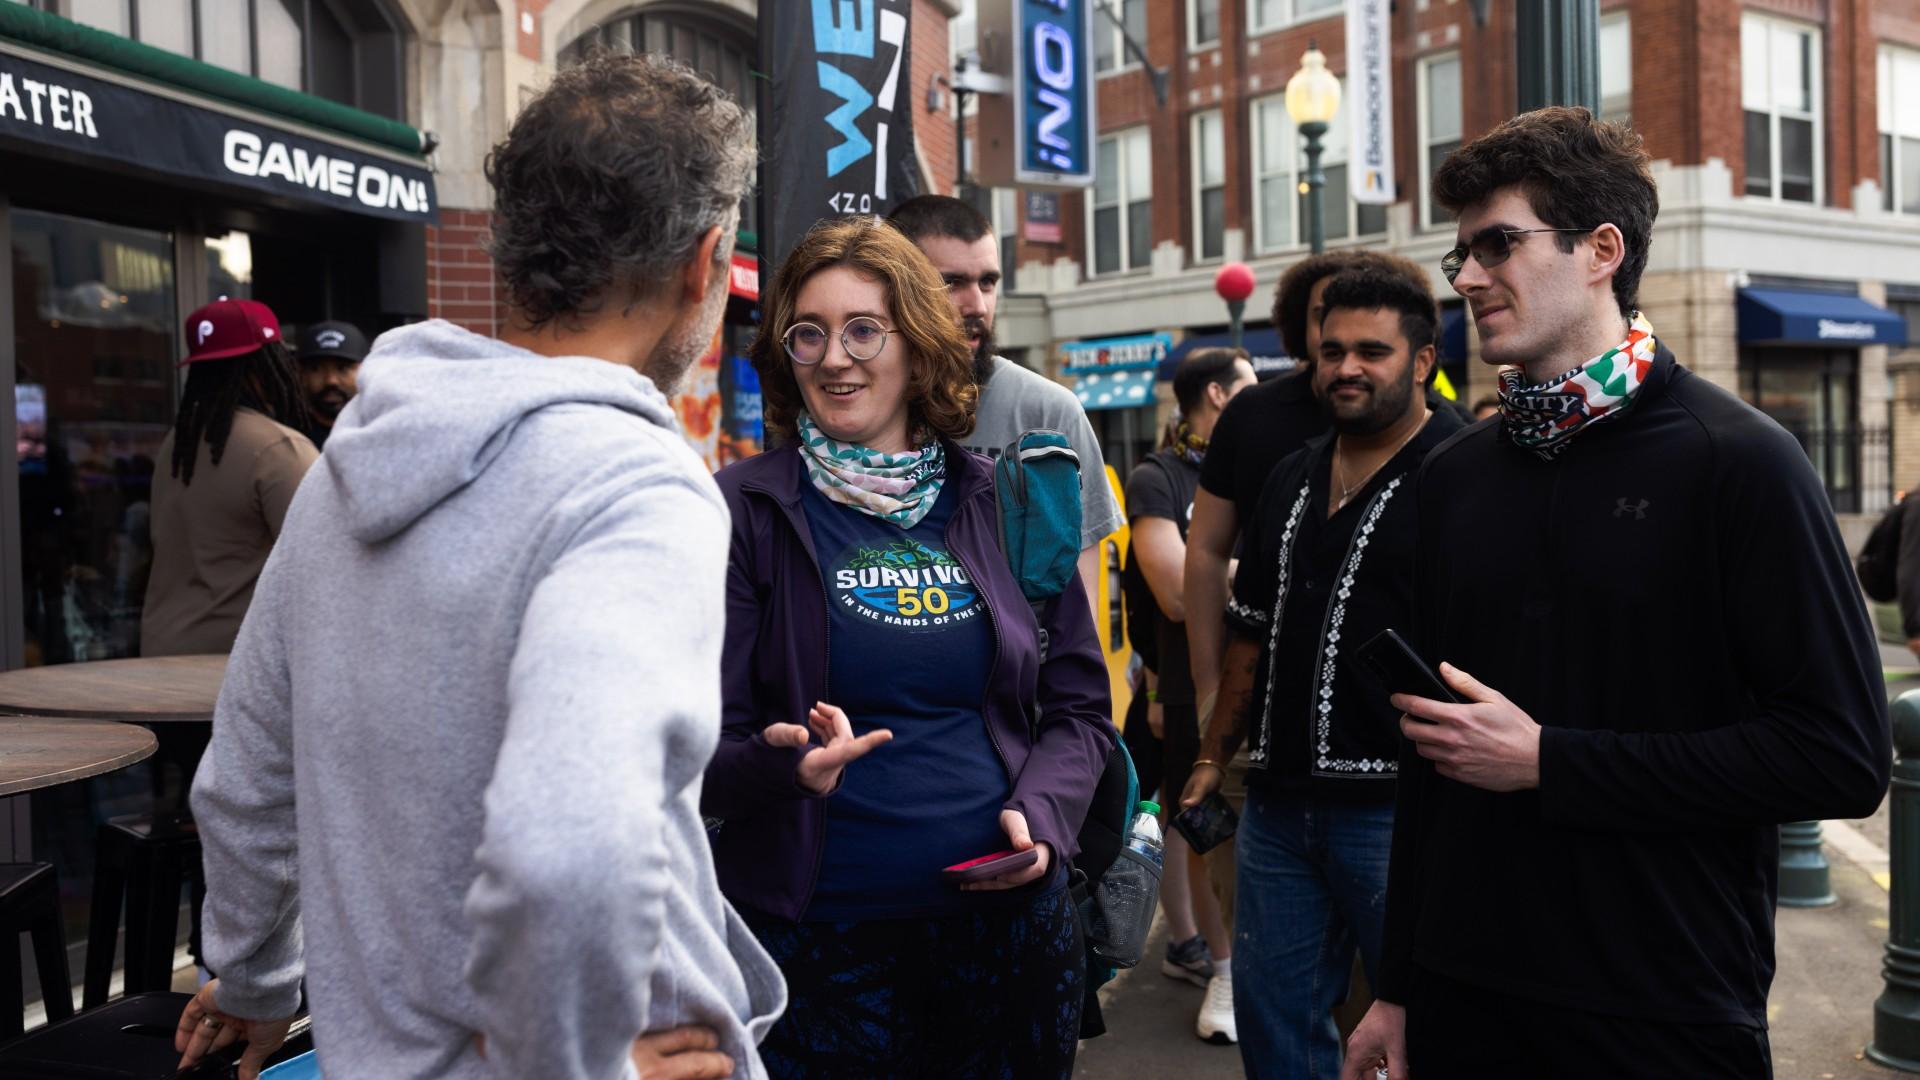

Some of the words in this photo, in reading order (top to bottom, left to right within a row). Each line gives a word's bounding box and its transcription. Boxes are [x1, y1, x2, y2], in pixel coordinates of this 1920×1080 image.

[0, 71, 99, 138] ATER
[223, 129, 355, 198] GAME
[356, 165, 429, 213] ON!
[197, 320, 214, 346] P
[841, 594, 855, 607] IN
[856, 604, 879, 620] THE
[884, 615, 929, 626] HANDS
[934, 615, 950, 625] OF
[953, 608, 975, 621] THE
[897, 586, 949, 616] 50
